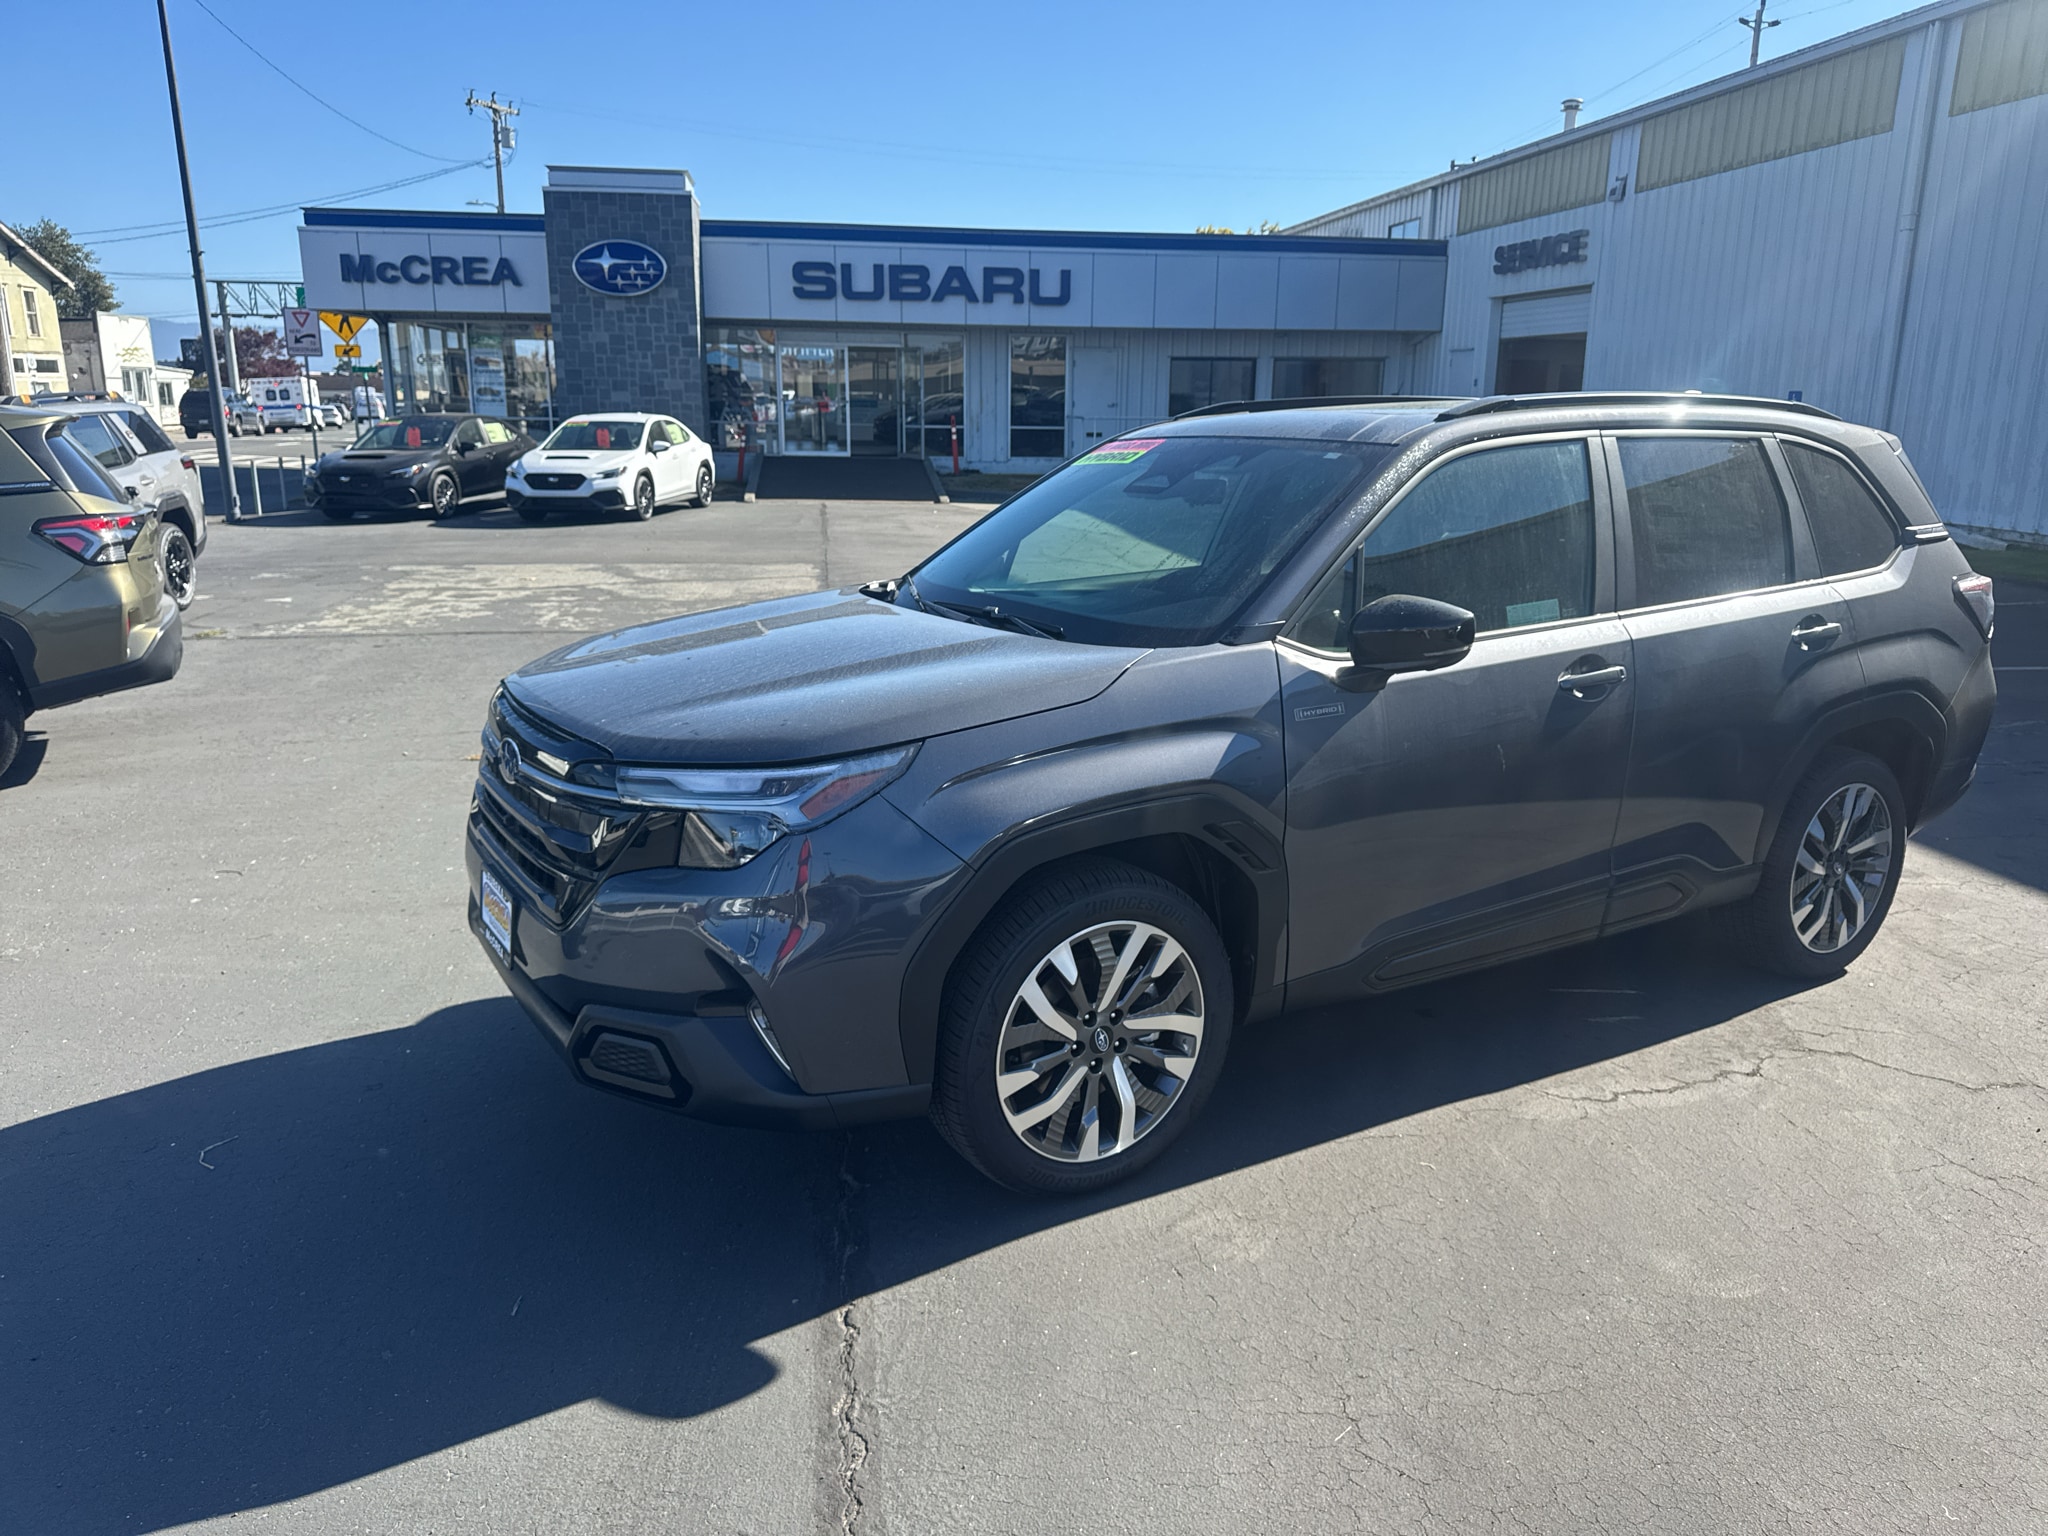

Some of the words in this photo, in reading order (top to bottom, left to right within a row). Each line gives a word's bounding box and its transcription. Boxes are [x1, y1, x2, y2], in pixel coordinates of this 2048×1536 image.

[1493, 229, 1589, 275] SERVICE
[340, 254, 522, 287] McCREA
[792, 261, 1072, 306] SUBARU
[1303, 706, 1338, 717] HYBRID
[1084, 896, 1189, 927] BRIDGESTONE
